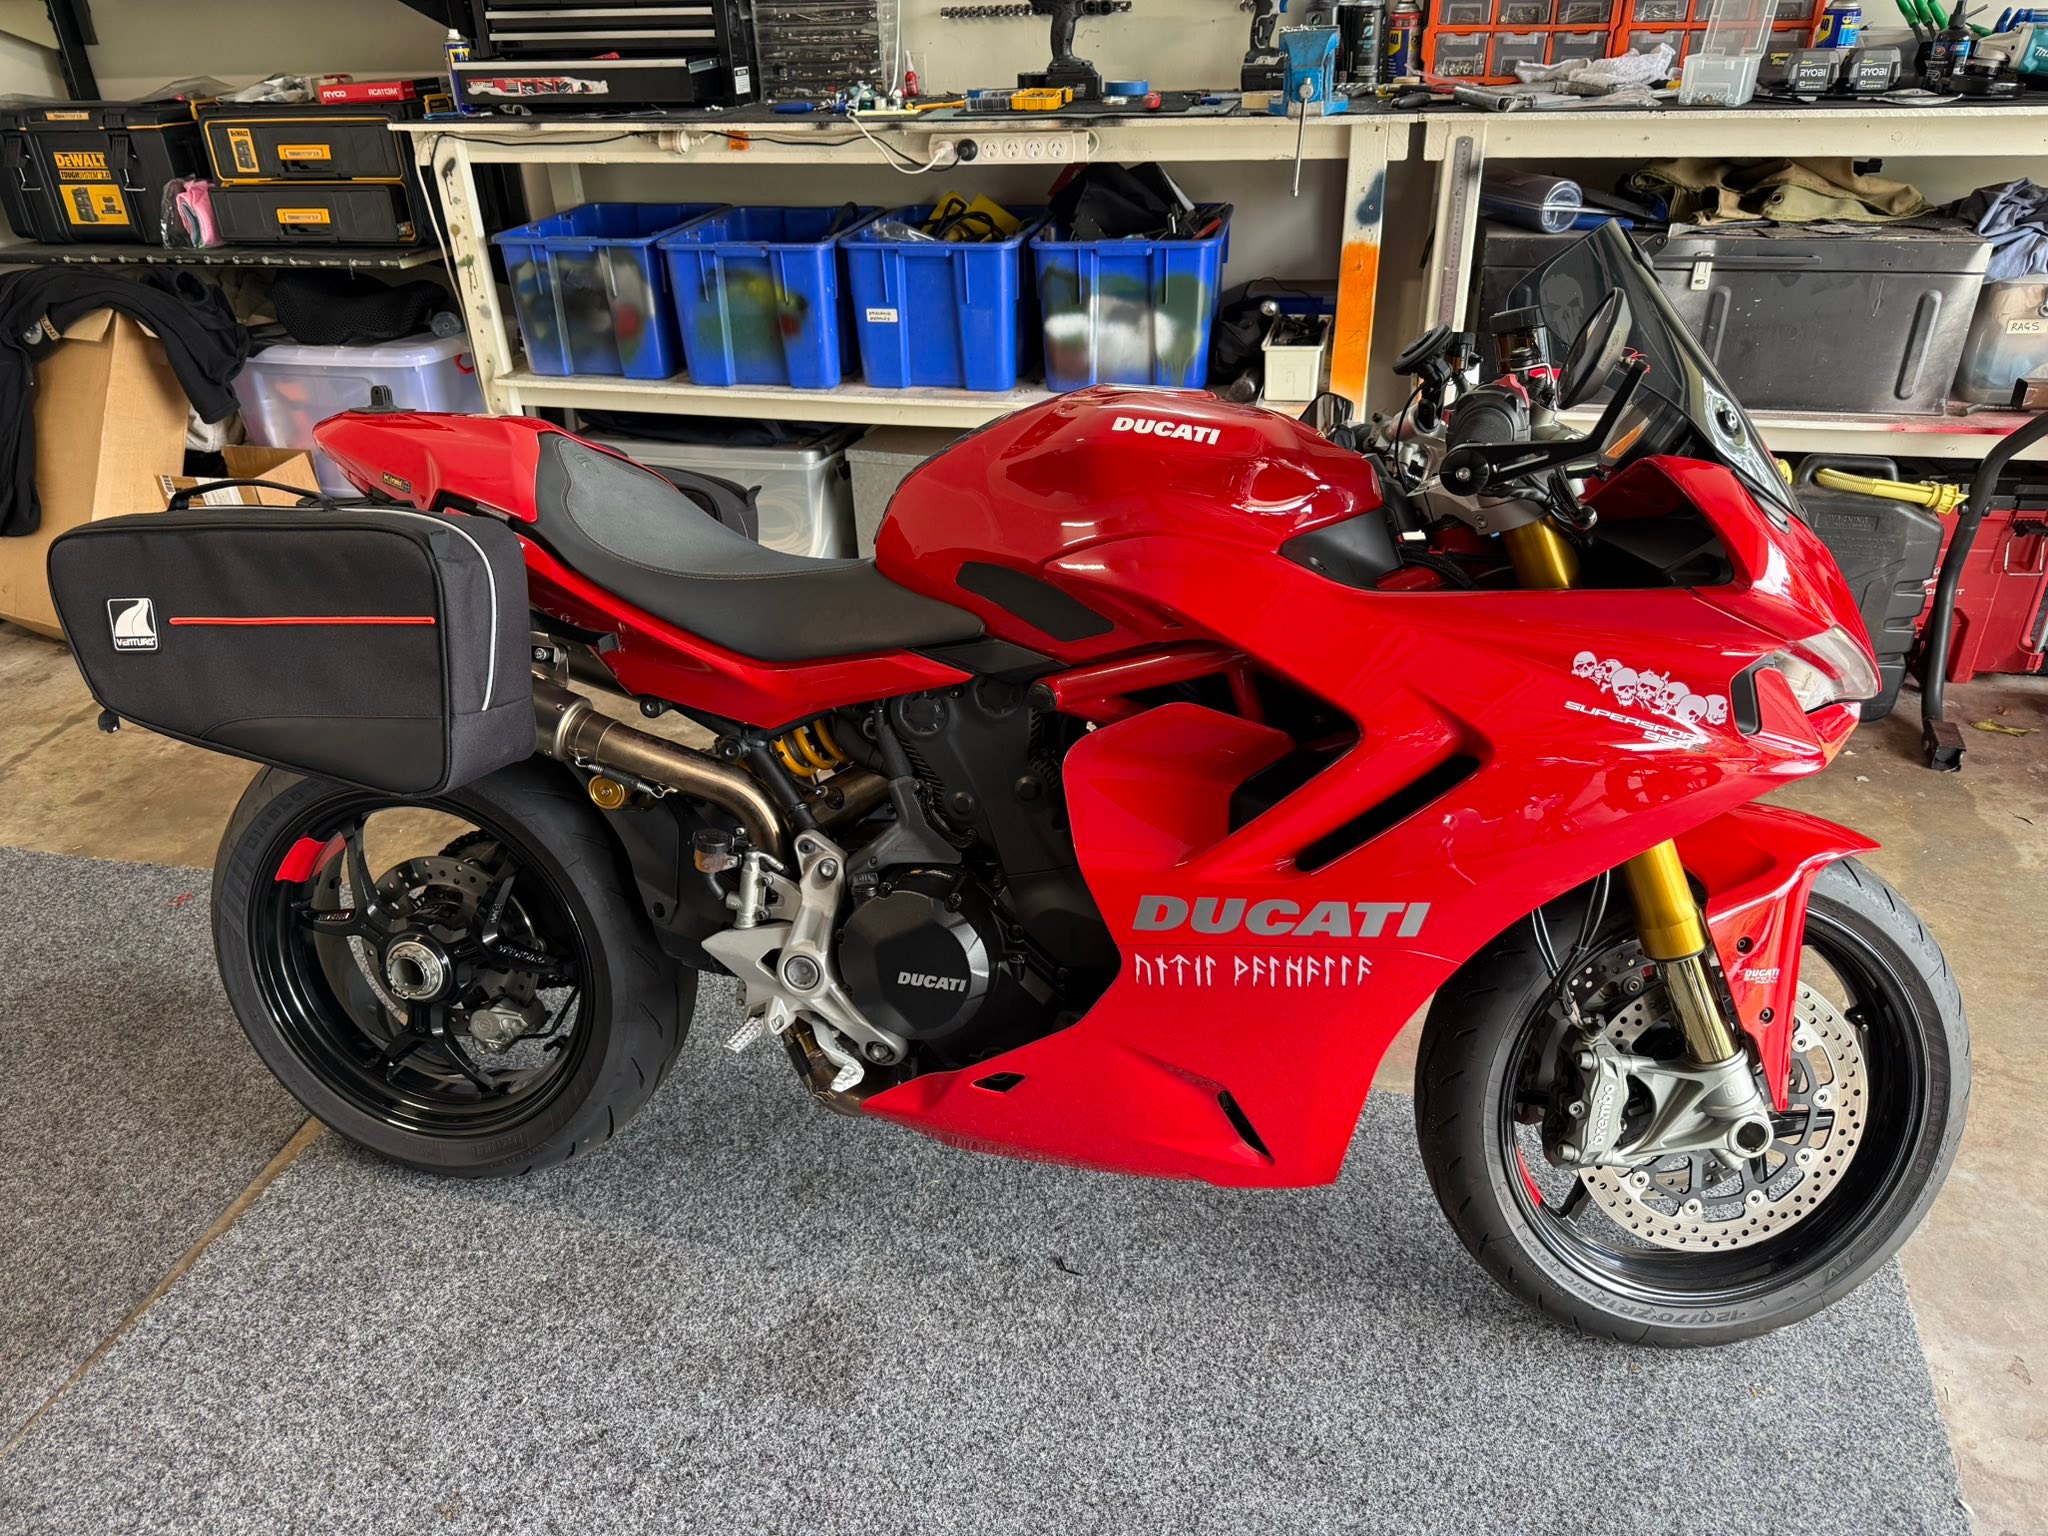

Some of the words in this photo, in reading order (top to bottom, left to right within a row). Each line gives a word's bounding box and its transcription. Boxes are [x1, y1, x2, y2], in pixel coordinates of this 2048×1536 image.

[1799, 68, 1826, 77] RYOBI
[1860, 67, 1888, 76] RYOBI
[322, 90, 347, 98] RYCO
[55, 153, 107, 168] DEWALT
[2010, 321, 2040, 331] RAGS
[1111, 416, 1221, 445] DUCATI
[1132, 895, 1431, 937] DUCATI
[1744, 968, 1780, 977] DUCATI
[897, 971, 967, 992] DUCATI
[1589, 1084, 1615, 1146] brembo
